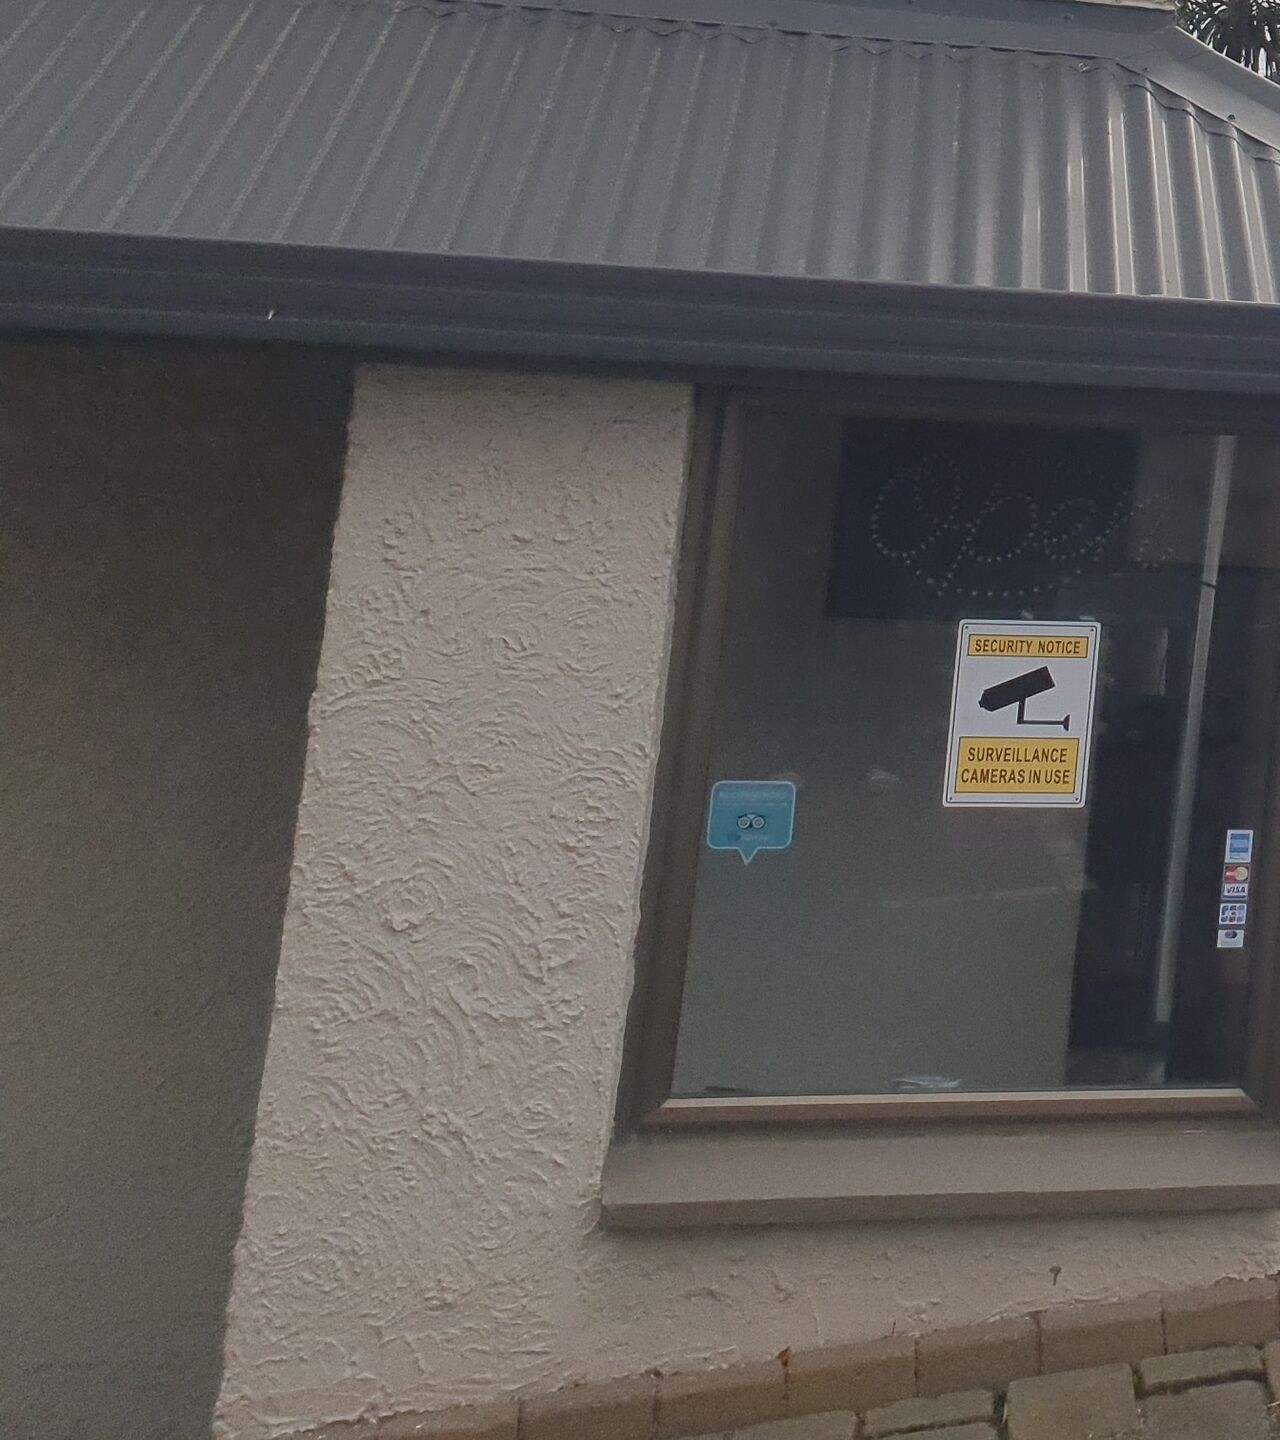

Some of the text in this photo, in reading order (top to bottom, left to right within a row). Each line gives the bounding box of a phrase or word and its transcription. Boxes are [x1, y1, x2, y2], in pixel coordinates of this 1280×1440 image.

[974, 638, 1081, 655] SECURITY NOTICE
[967, 746, 1069, 764] SURVEILLANCE
[960, 768, 1071, 785] CAMERAS IN USE
[1226, 886, 1246, 894] VISA
